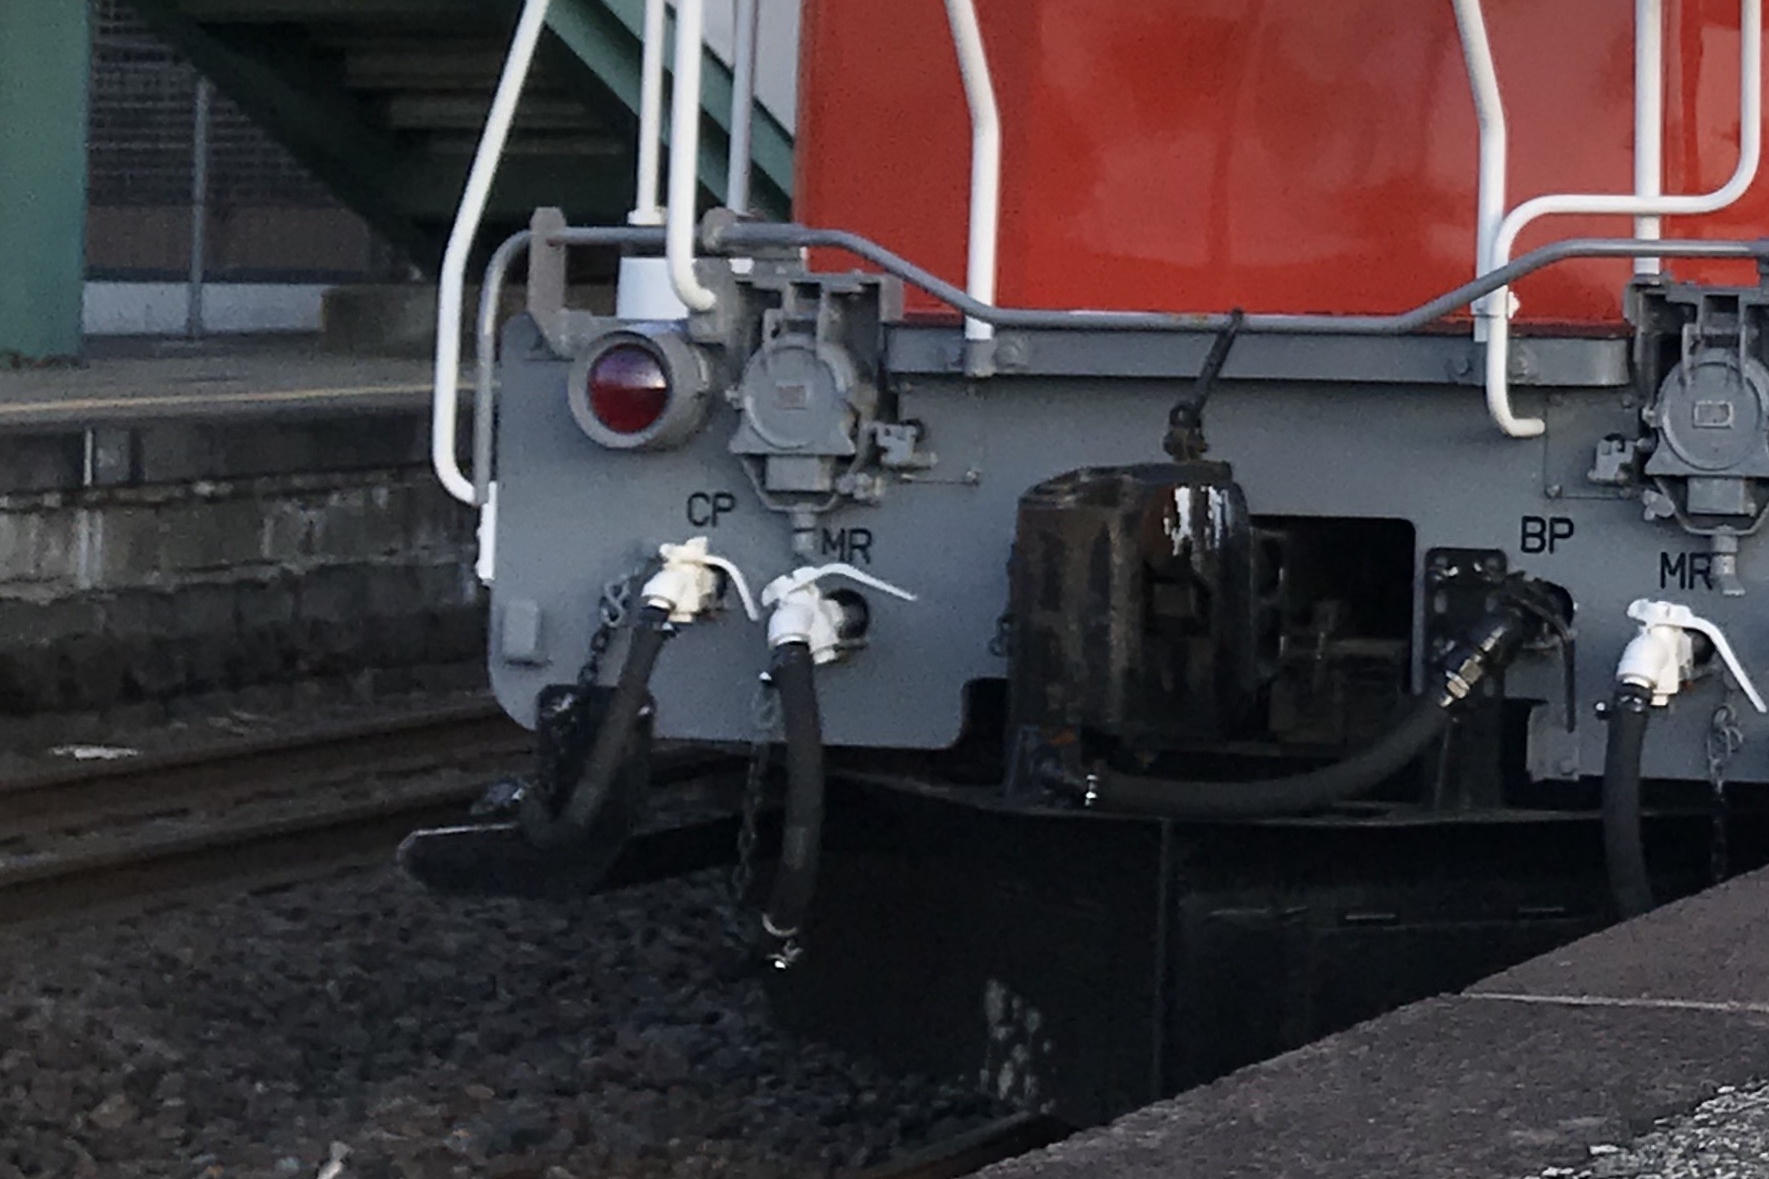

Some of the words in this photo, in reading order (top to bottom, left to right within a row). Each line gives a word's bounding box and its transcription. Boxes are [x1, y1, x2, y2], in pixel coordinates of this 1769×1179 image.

[686, 492, 736, 528] CP
[821, 527, 873, 565] MR
[1520, 515, 1575, 555] BP
[1659, 551, 1714, 590] MR
